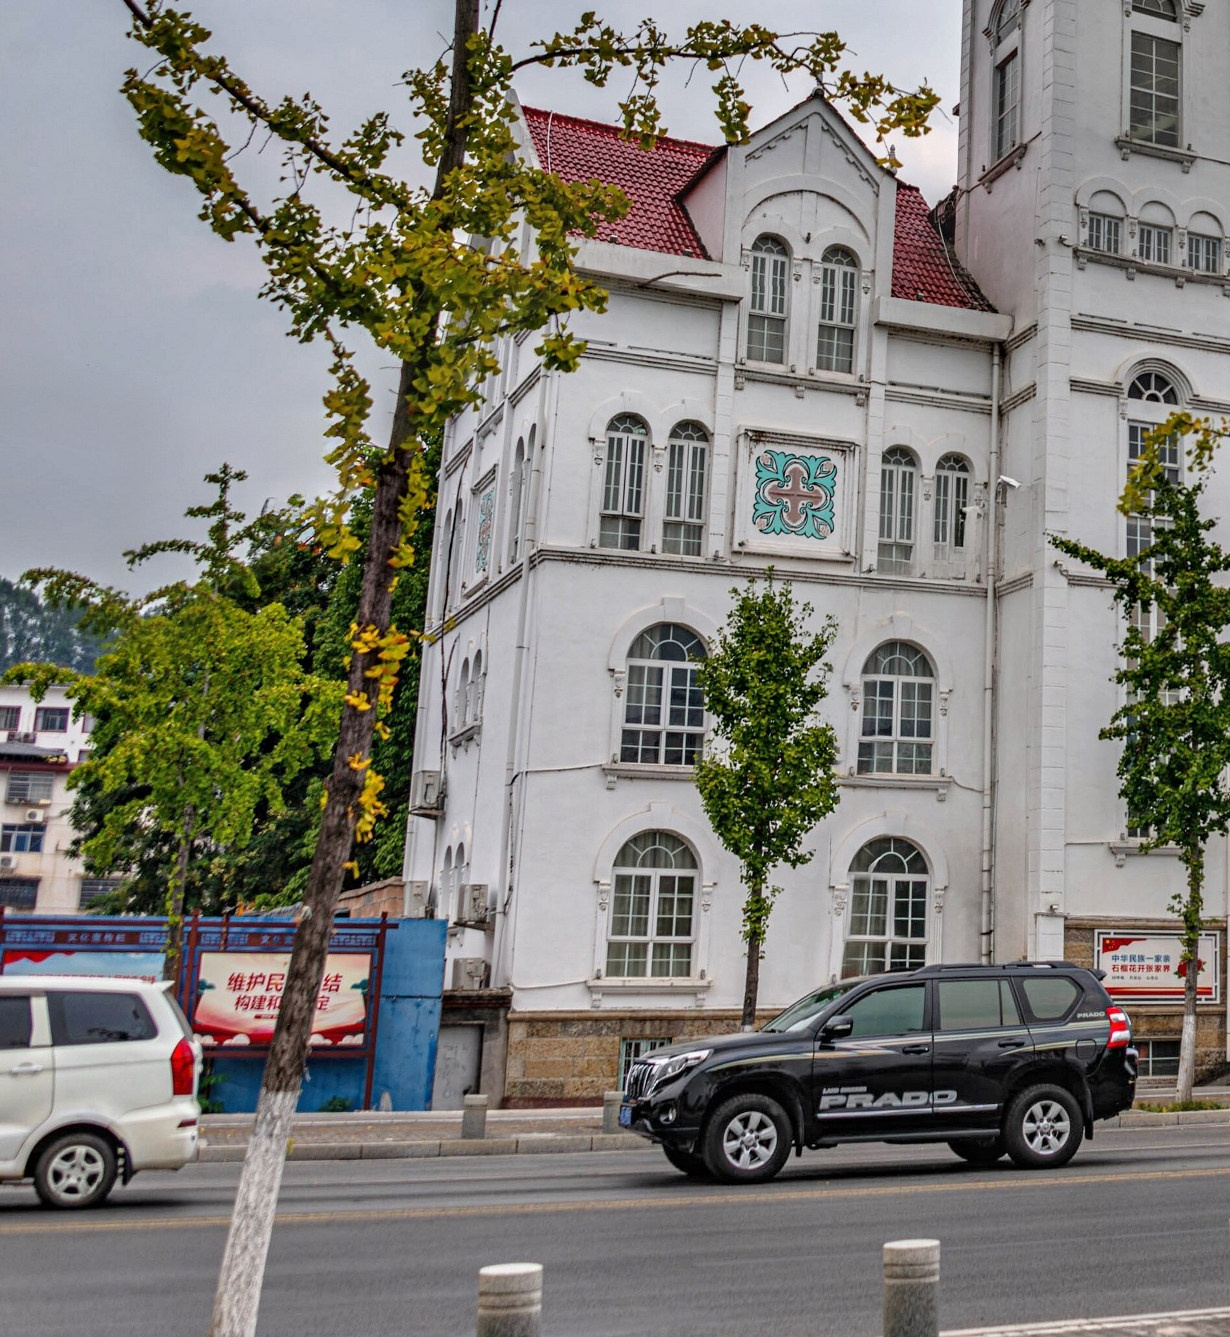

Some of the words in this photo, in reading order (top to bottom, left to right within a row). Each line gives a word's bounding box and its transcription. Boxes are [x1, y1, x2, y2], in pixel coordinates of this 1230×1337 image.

[1111, 954, 1170, 962] 中华民族一家亲
[1111, 964, 1170, 972] 石榴花开张家界
[227, 972, 343, 993] 维护民结
[234, 994, 330, 1012] 构建和定
[819, 1090, 958, 1110] PRADO
